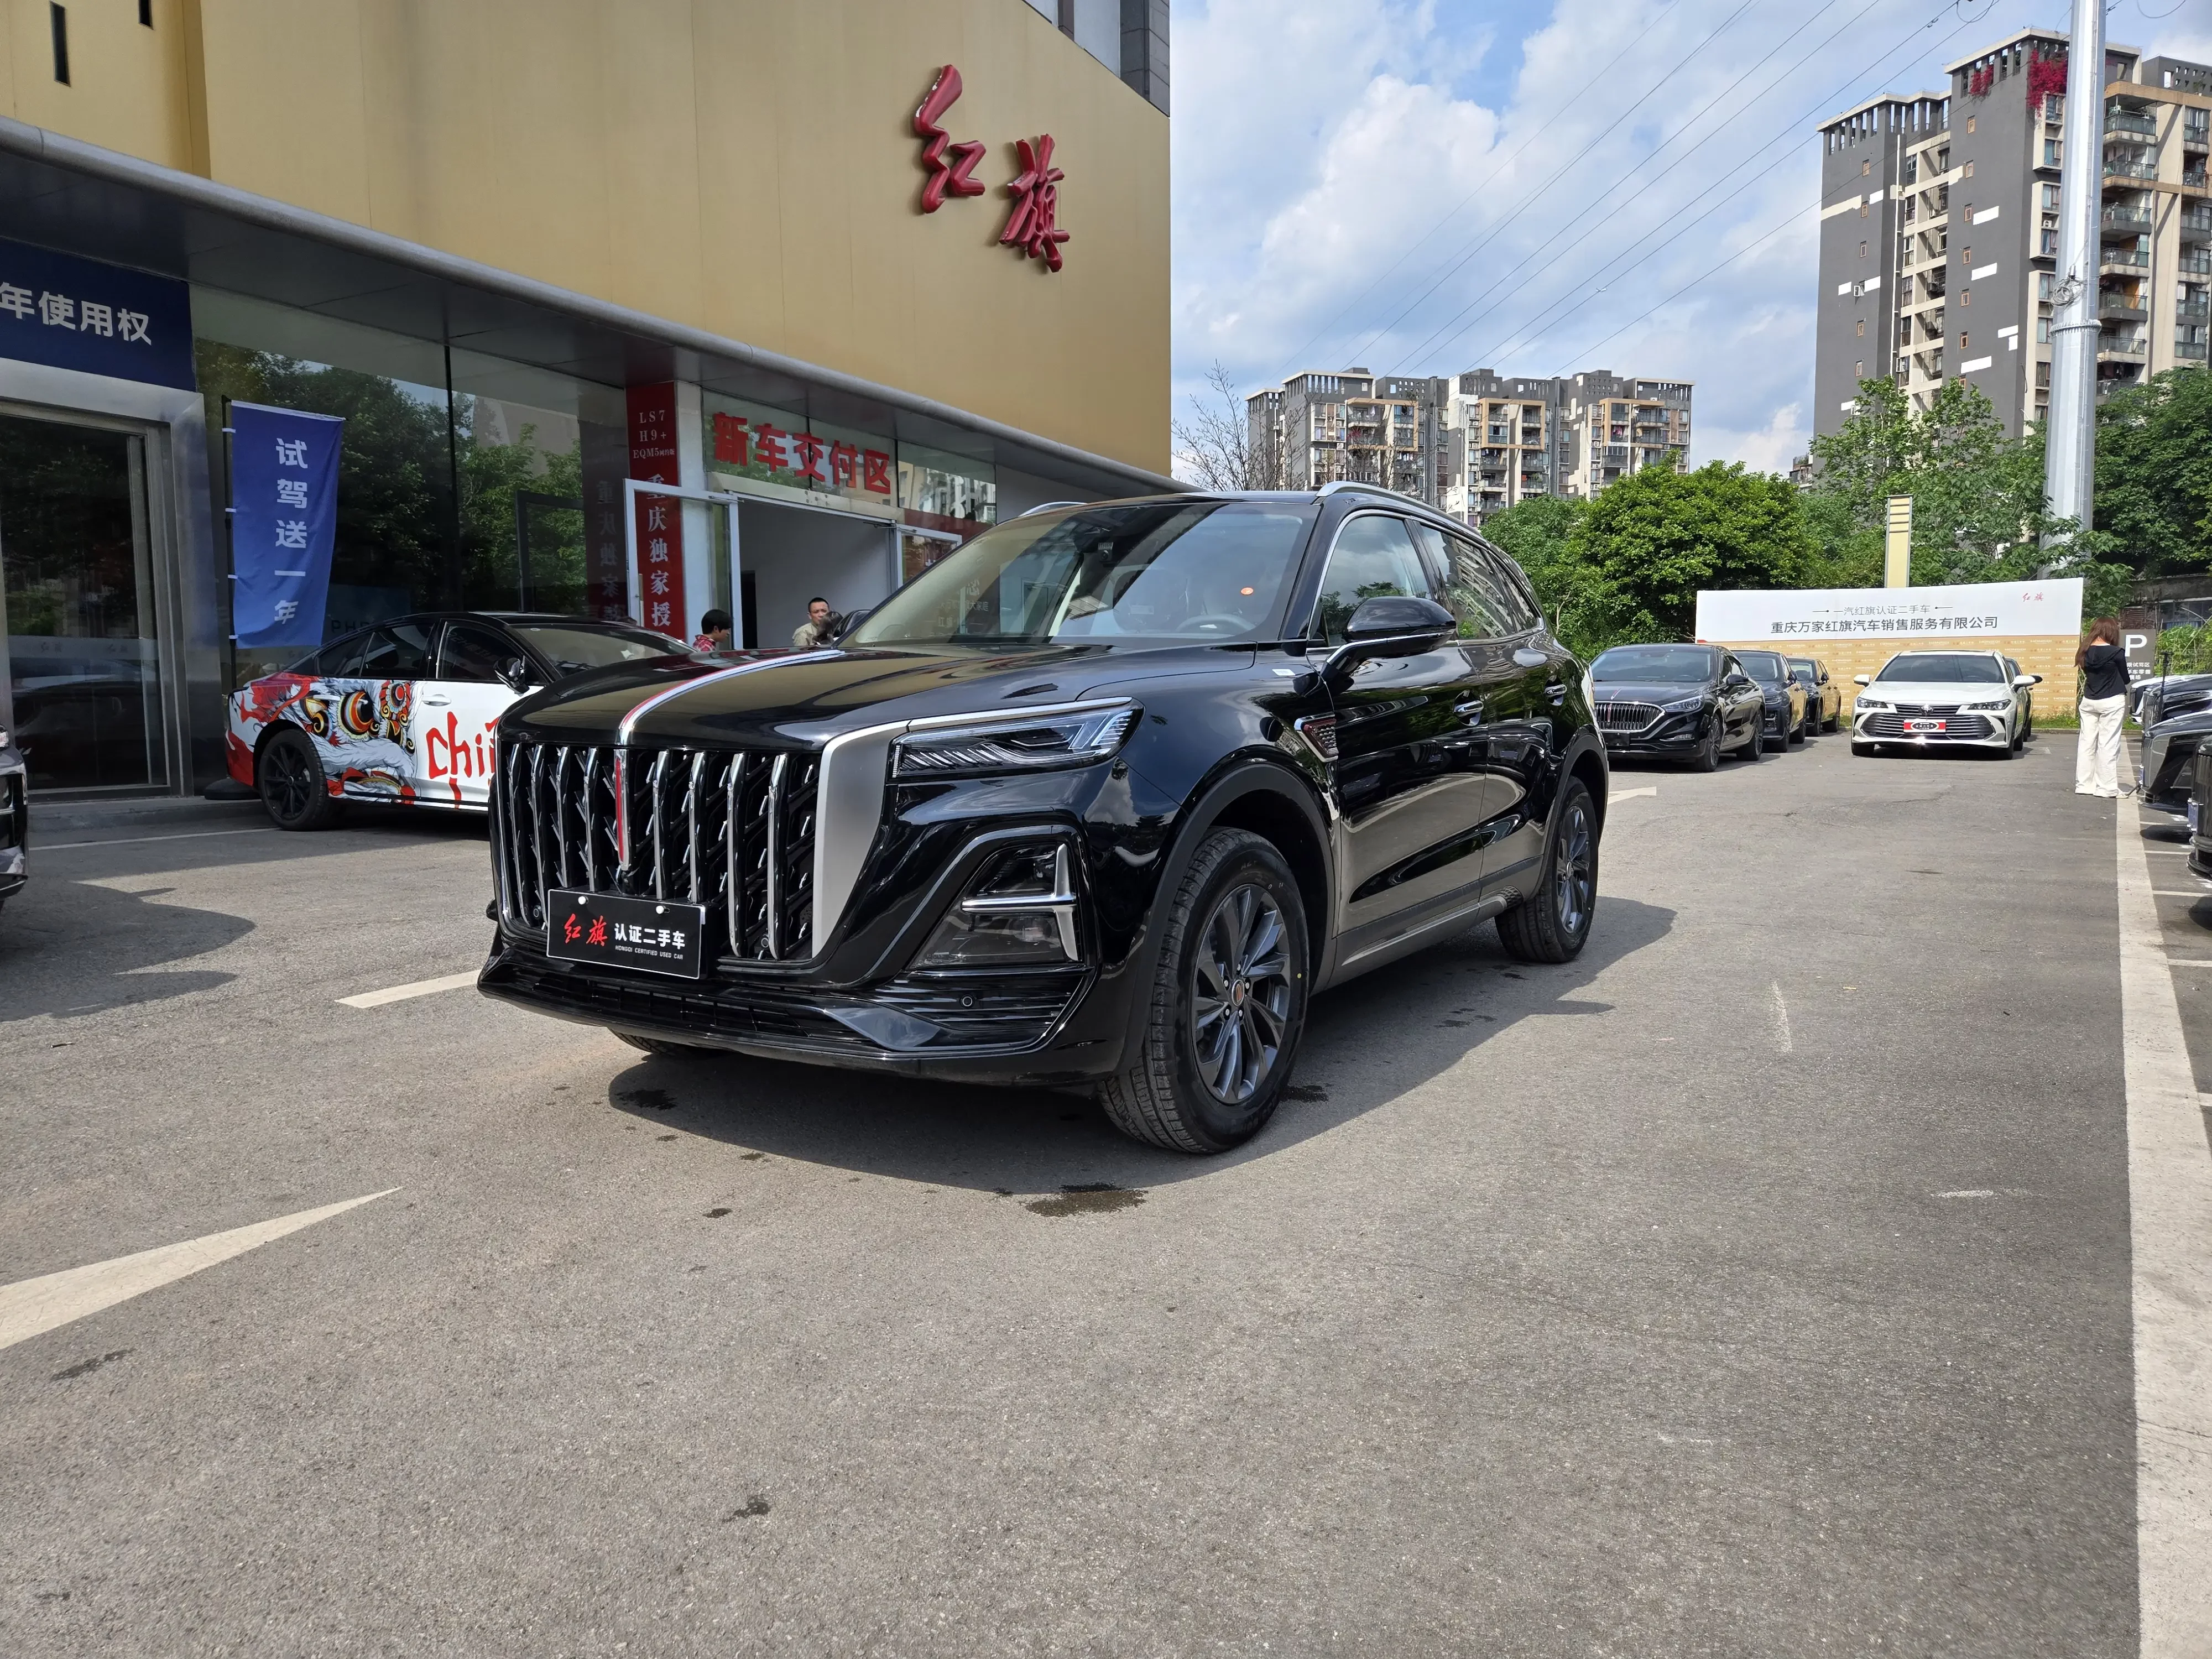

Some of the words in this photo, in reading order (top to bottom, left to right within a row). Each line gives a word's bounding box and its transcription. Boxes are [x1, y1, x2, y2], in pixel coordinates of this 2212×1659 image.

[914, 64, 1070, 273] 红旗
[0, 282, 152, 346] 年使用权
[639, 410, 665, 424] LS7
[639, 429, 667, 442] H9+
[712, 411, 891, 494] 新车交付区
[274, 438, 309, 625] 试驾送一年
[2022, 592, 2044, 602] 红旗
[1833, 604, 1931, 616] 一汽红旗认证二手车
[1771, 616, 1998, 634] 重庆万家红旗汽车销售服务有限公司
[2125, 634, 2147, 657] P
[564, 913, 608, 947] 红旗
[614, 923, 685, 950] 认证二手车
[634, 947, 658, 956] CERTIFIED
